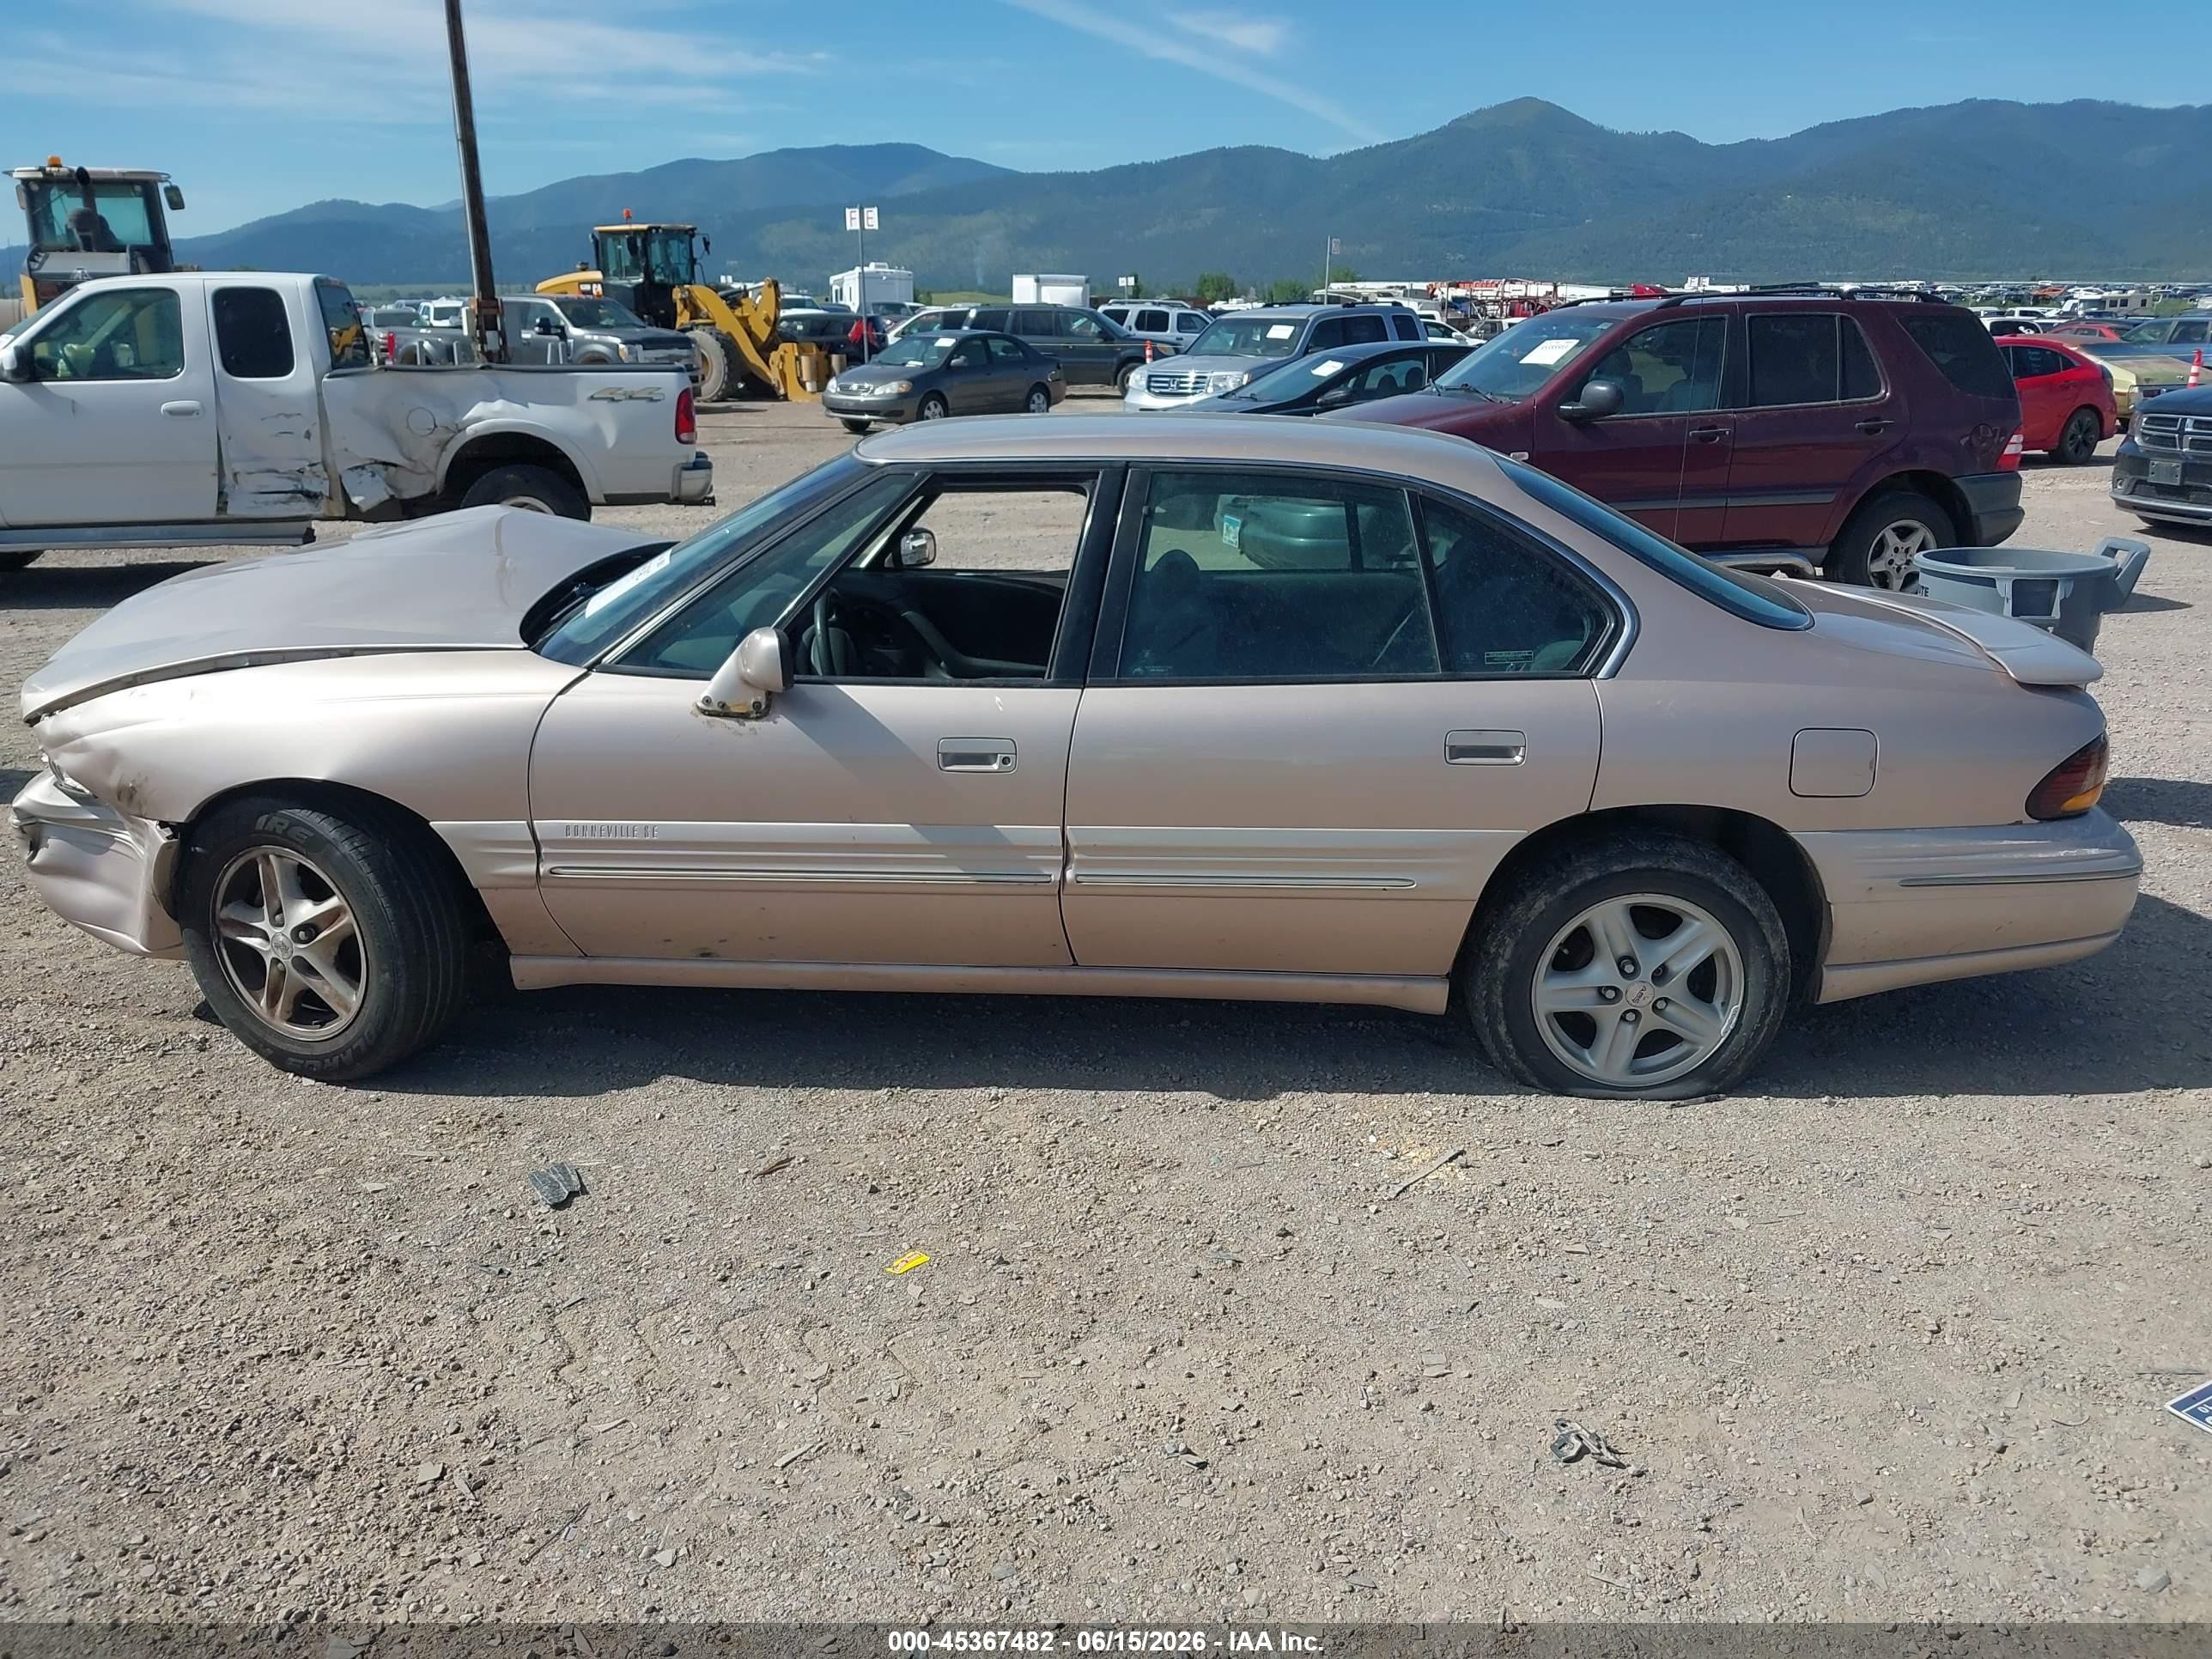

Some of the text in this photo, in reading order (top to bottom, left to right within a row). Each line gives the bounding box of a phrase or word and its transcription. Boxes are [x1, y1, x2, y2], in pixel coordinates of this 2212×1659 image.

[849, 210, 857, 228] F
[866, 210, 874, 228] E
[565, 824, 659, 839] BONNEVILLE SE
